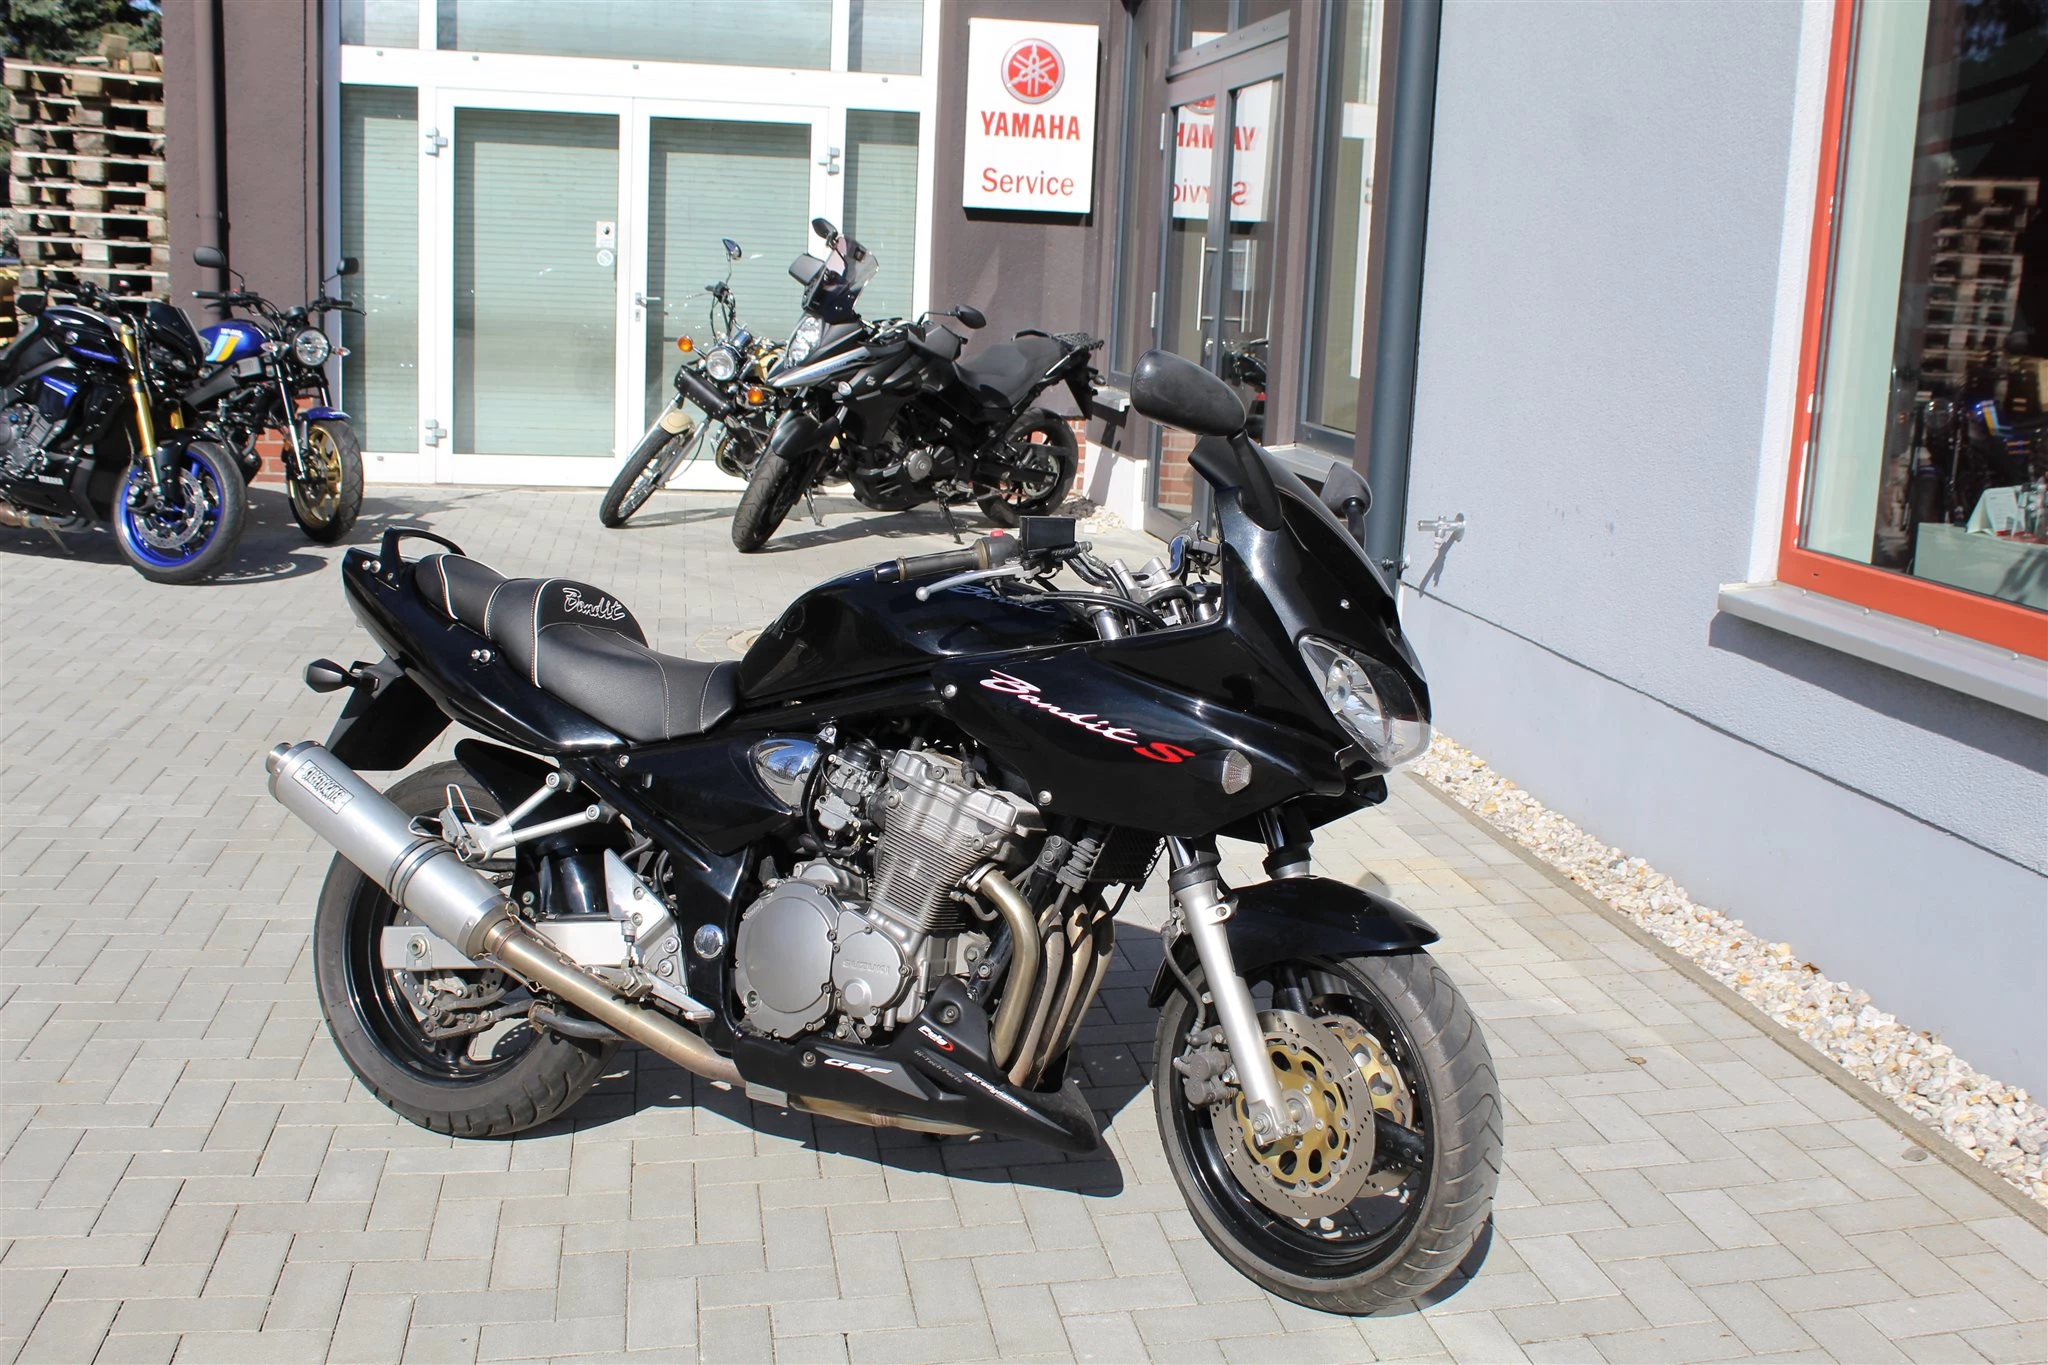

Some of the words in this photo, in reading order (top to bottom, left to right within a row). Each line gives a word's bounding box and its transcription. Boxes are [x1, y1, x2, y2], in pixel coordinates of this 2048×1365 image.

[981, 110, 1081, 141] YAMAHA
[981, 167, 1075, 196] Service
[562, 587, 626, 621] Bandit
[979, 669, 1138, 744] Bandit
[1132, 742, 1196, 763] S
[842, 959, 891, 975] SUZUKI
[918, 1025, 949, 1046] Puig
[823, 1058, 893, 1074] GSF
[964, 1072, 1028, 1112] Aerodynamics
